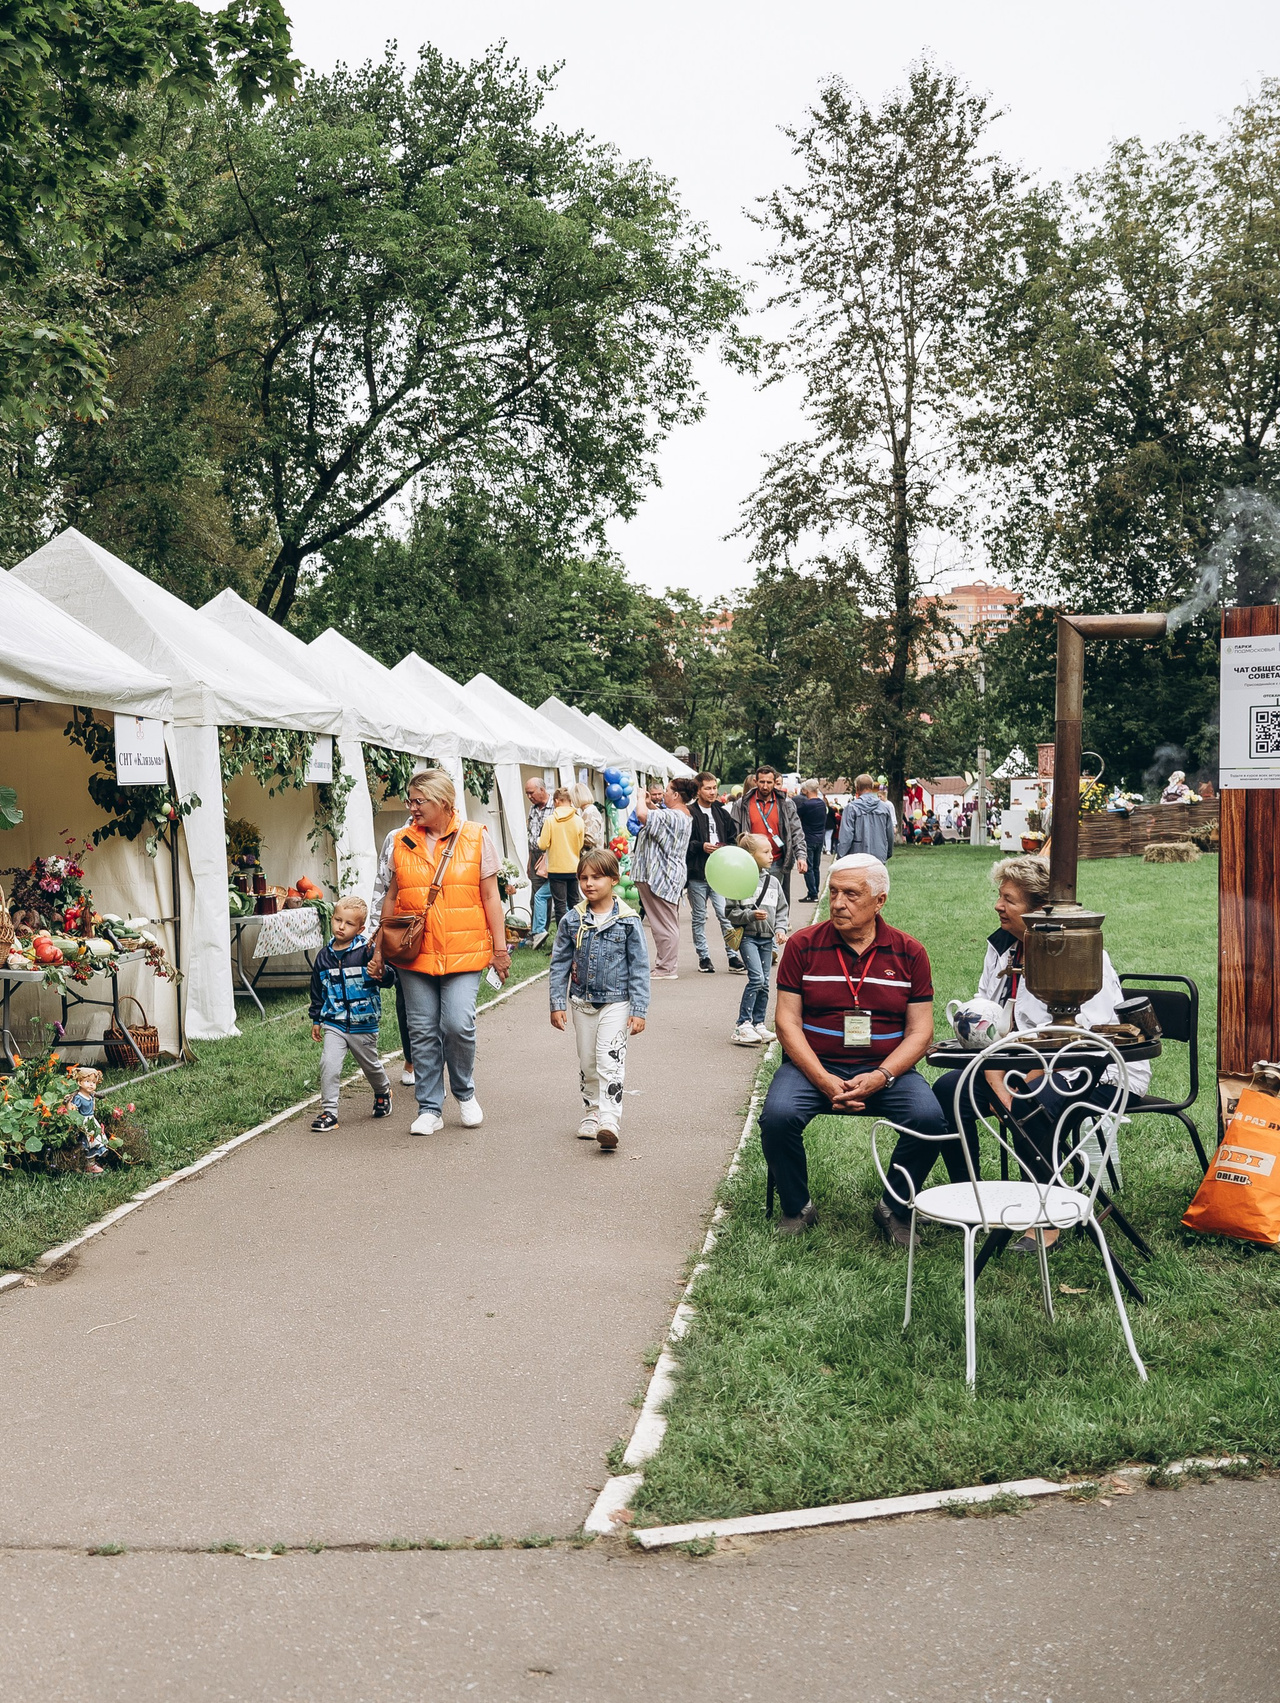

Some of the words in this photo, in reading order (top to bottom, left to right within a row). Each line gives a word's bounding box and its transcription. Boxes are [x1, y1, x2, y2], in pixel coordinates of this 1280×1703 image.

[1248, 672, 1280, 680] СОВЕТА
[118, 752, 133, 766] СНТ
[1244, 1115, 1266, 1127] РАЗ
[1220, 1149, 1263, 1168] OBI
[1216, 1171, 1247, 1183] OBI.RU
